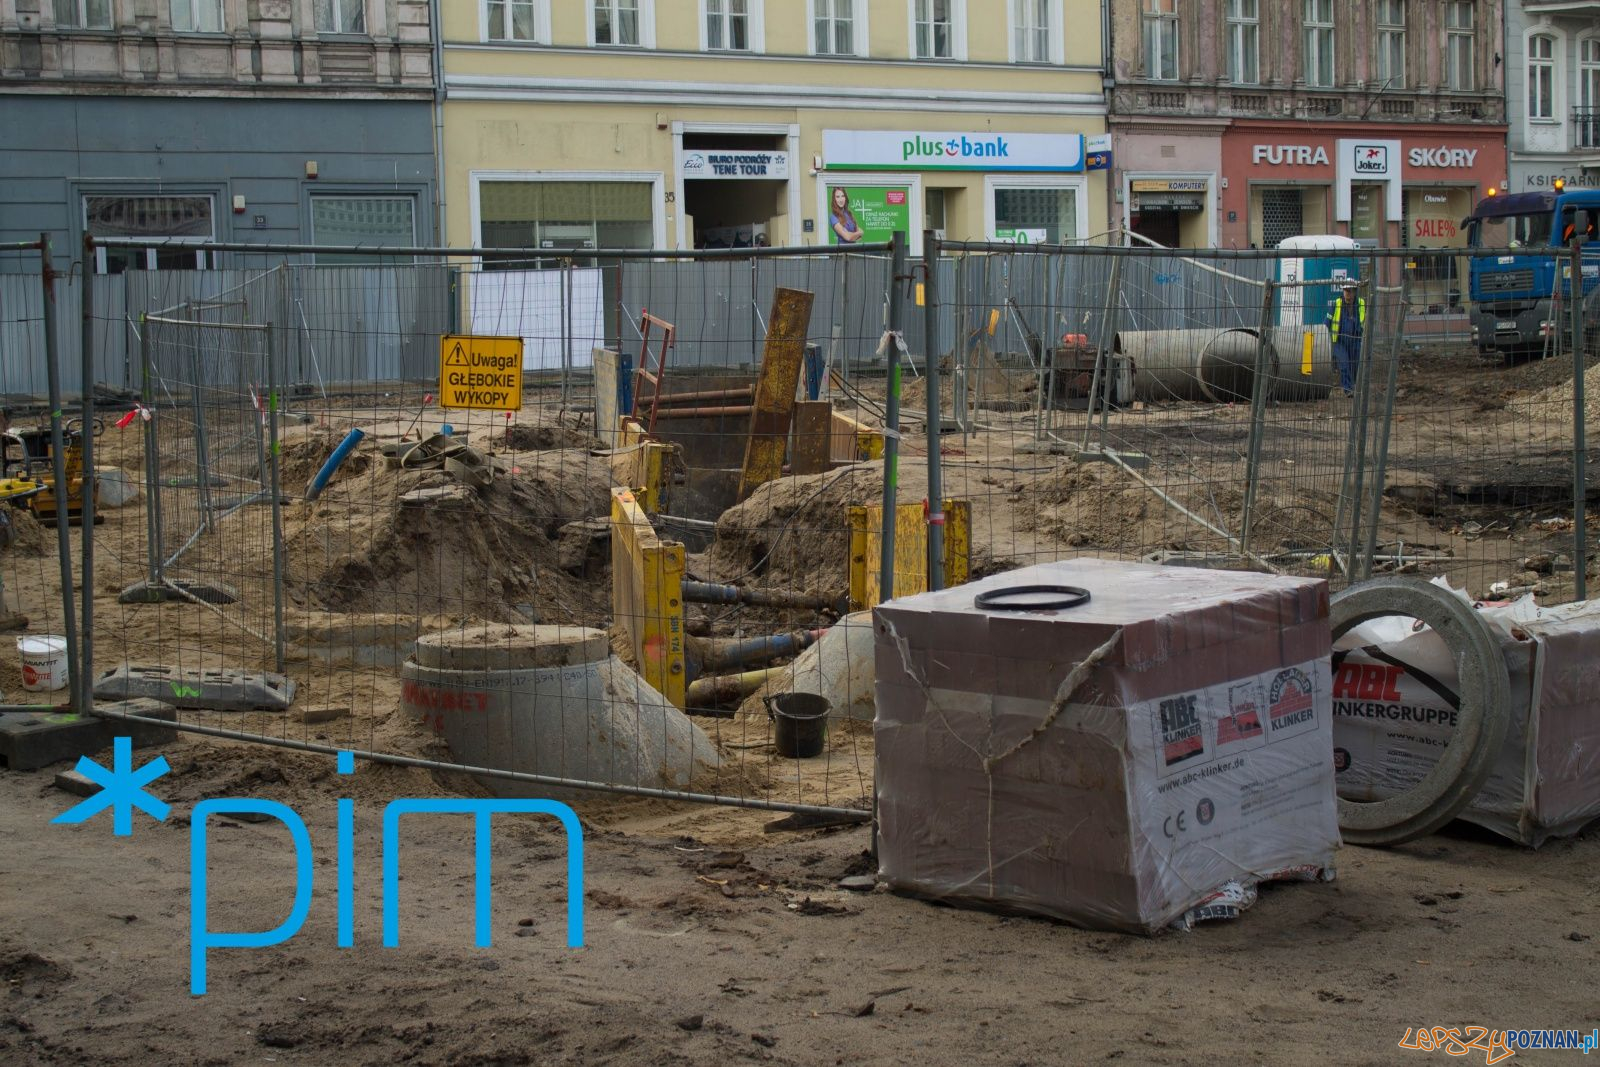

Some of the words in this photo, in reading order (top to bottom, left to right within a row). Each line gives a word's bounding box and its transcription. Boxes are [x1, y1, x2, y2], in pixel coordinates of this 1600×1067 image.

[903, 135, 943, 160] plus
[961, 136, 1008, 157] bank
[1253, 145, 1329, 165] FUTRA
[1408, 145, 1478, 167] SKÓRY
[708, 155, 733, 164] BIURO
[1357, 160, 1382, 170] Joker
[713, 164, 737, 175] TENE
[740, 165, 767, 175] TOUR
[1168, 182, 1206, 190] KOMPUTERY
[1415, 219, 1456, 238] SALE%
[472, 353, 518, 371] Uwaga!
[448, 372, 515, 390] GŁĘBOKIE
[454, 390, 509, 405] WYKOPY
[1333, 663, 1406, 702] ABC
[1160, 695, 1200, 733] ABC
[1271, 708, 1314, 731] KLINKER
[1163, 724, 1202, 744] KLINKER
[1157, 757, 1245, 794] www.abc-klinker.de
